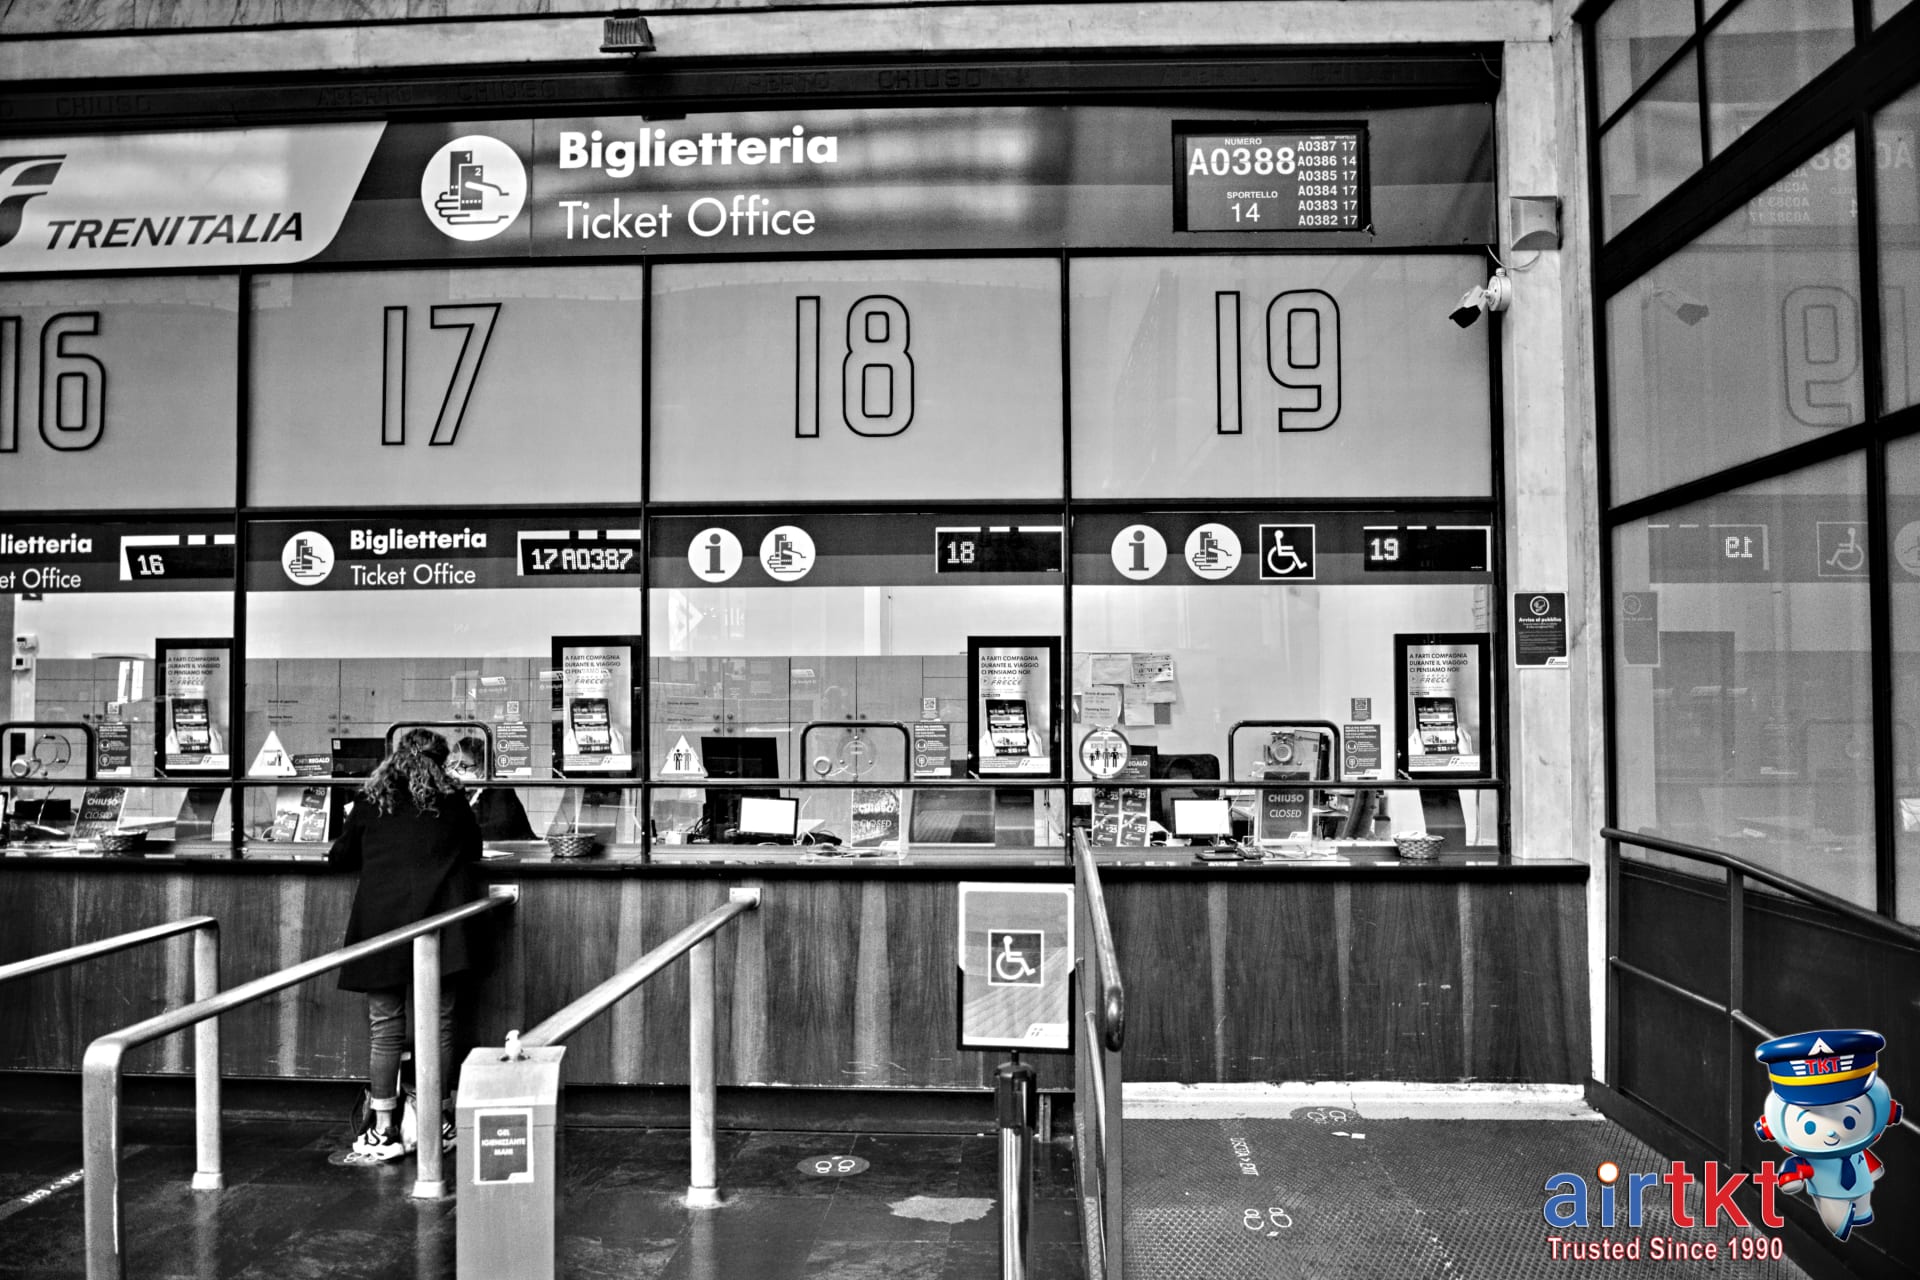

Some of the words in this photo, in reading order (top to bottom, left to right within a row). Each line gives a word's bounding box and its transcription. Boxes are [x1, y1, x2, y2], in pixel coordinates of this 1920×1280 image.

[559, 125, 838, 178] Biglietteria
[1224, 137, 1262, 145] NUMERO
[1297, 141, 1337, 151] A0387
[1342, 141, 1357, 151] 17
[1188, 147, 1296, 176] A0388
[1297, 156, 1337, 166] A0386
[1342, 156, 1357, 166] 14
[1297, 171, 1338, 181] A0385
[1342, 171, 1357, 181] 17
[1226, 191, 1278, 200] SPORTELLO
[1297, 185, 1338, 196] A0384
[1343, 185, 1358, 196] 17
[1231, 203, 1261, 223] 14
[1298, 200, 1338, 210] A0383
[1343, 200, 1358, 210] 17
[559, 199, 672, 239] Ticket
[687, 194, 816, 237] Office
[1298, 215, 1338, 226] A0382
[1343, 215, 1358, 226] 17
[46, 212, 303, 249] TRENITALIA
[795, 295, 914, 438] 18
[1216, 289, 1342, 433] 19
[0, 311, 106, 452] 16
[381, 303, 502, 446] 17
[350, 528, 487, 555] Biglietteria
[947, 541, 975, 564] 18
[1371, 538, 1399, 561] 19
[137, 554, 165, 576] 16
[531, 549, 557, 570] 17
[561, 548, 633, 570] A0387
[22, 567, 82, 589] Office
[350, 564, 406, 586] Ticket
[413, 563, 476, 585] Office
[1268, 794, 1305, 803] CHIUSO
[1269, 809, 1302, 818] CLOSED
